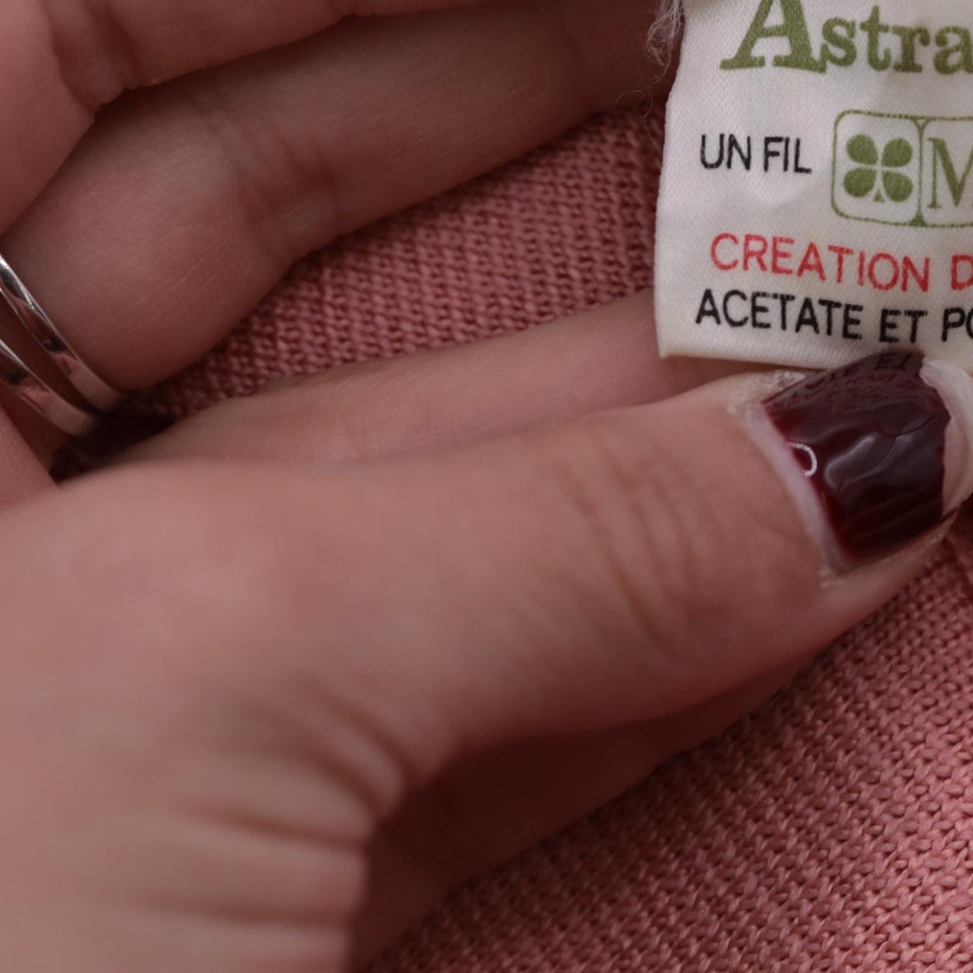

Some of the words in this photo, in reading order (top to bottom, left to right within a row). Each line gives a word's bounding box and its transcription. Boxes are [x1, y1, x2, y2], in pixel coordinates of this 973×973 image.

[700, 133, 751, 173] UN
[763, 137, 812, 174] FIL
[710, 232, 930, 293] CREATION
[695, 288, 863, 340] ACETATE
[878, 307, 928, 344] ET
